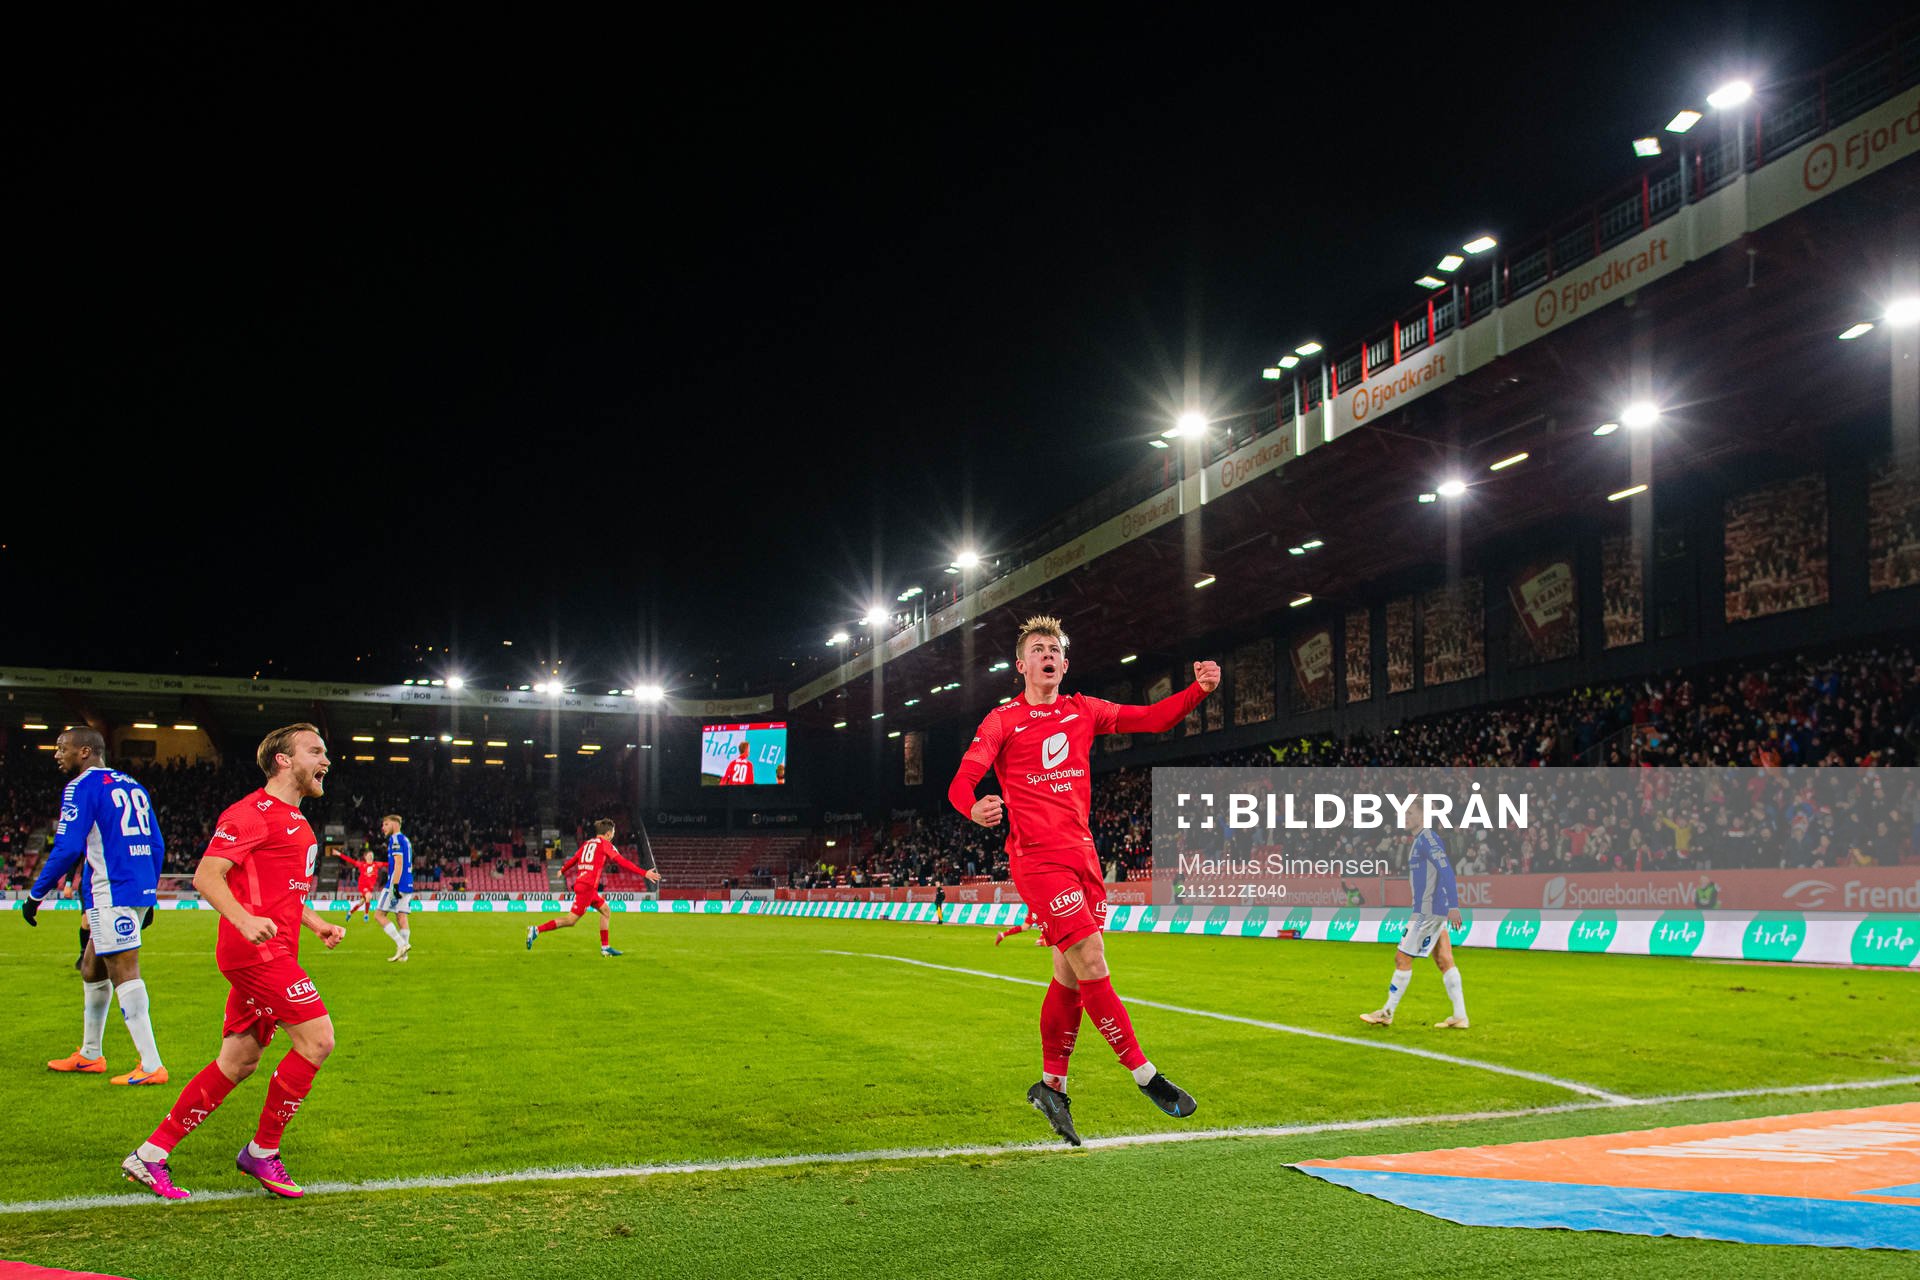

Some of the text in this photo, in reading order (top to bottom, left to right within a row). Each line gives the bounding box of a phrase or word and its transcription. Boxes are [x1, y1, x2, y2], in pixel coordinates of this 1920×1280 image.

[1561, 238, 1669, 313] Fjordkraft
[1371, 354, 1446, 411] Fjordkraft
[1235, 436, 1290, 481] Fjordkraft
[413, 692, 431, 700] BOB
[705, 732, 737, 759] tide
[732, 763, 747, 782] 20
[1026, 767, 1085, 785] Sparebanken
[1050, 781, 1073, 793] Vest
[111, 787, 151, 837] 28
[580, 843, 598, 863] 18
[435, 892, 467, 901] 07000
[522, 892, 553, 901] 07000
[605, 892, 634, 901] 07000
[1504, 920, 1535, 938] tide
[1576, 921, 1610, 940] tide
[1658, 922, 1697, 943] tide
[1752, 924, 1798, 947] tide
[1862, 927, 1915, 951] tide
